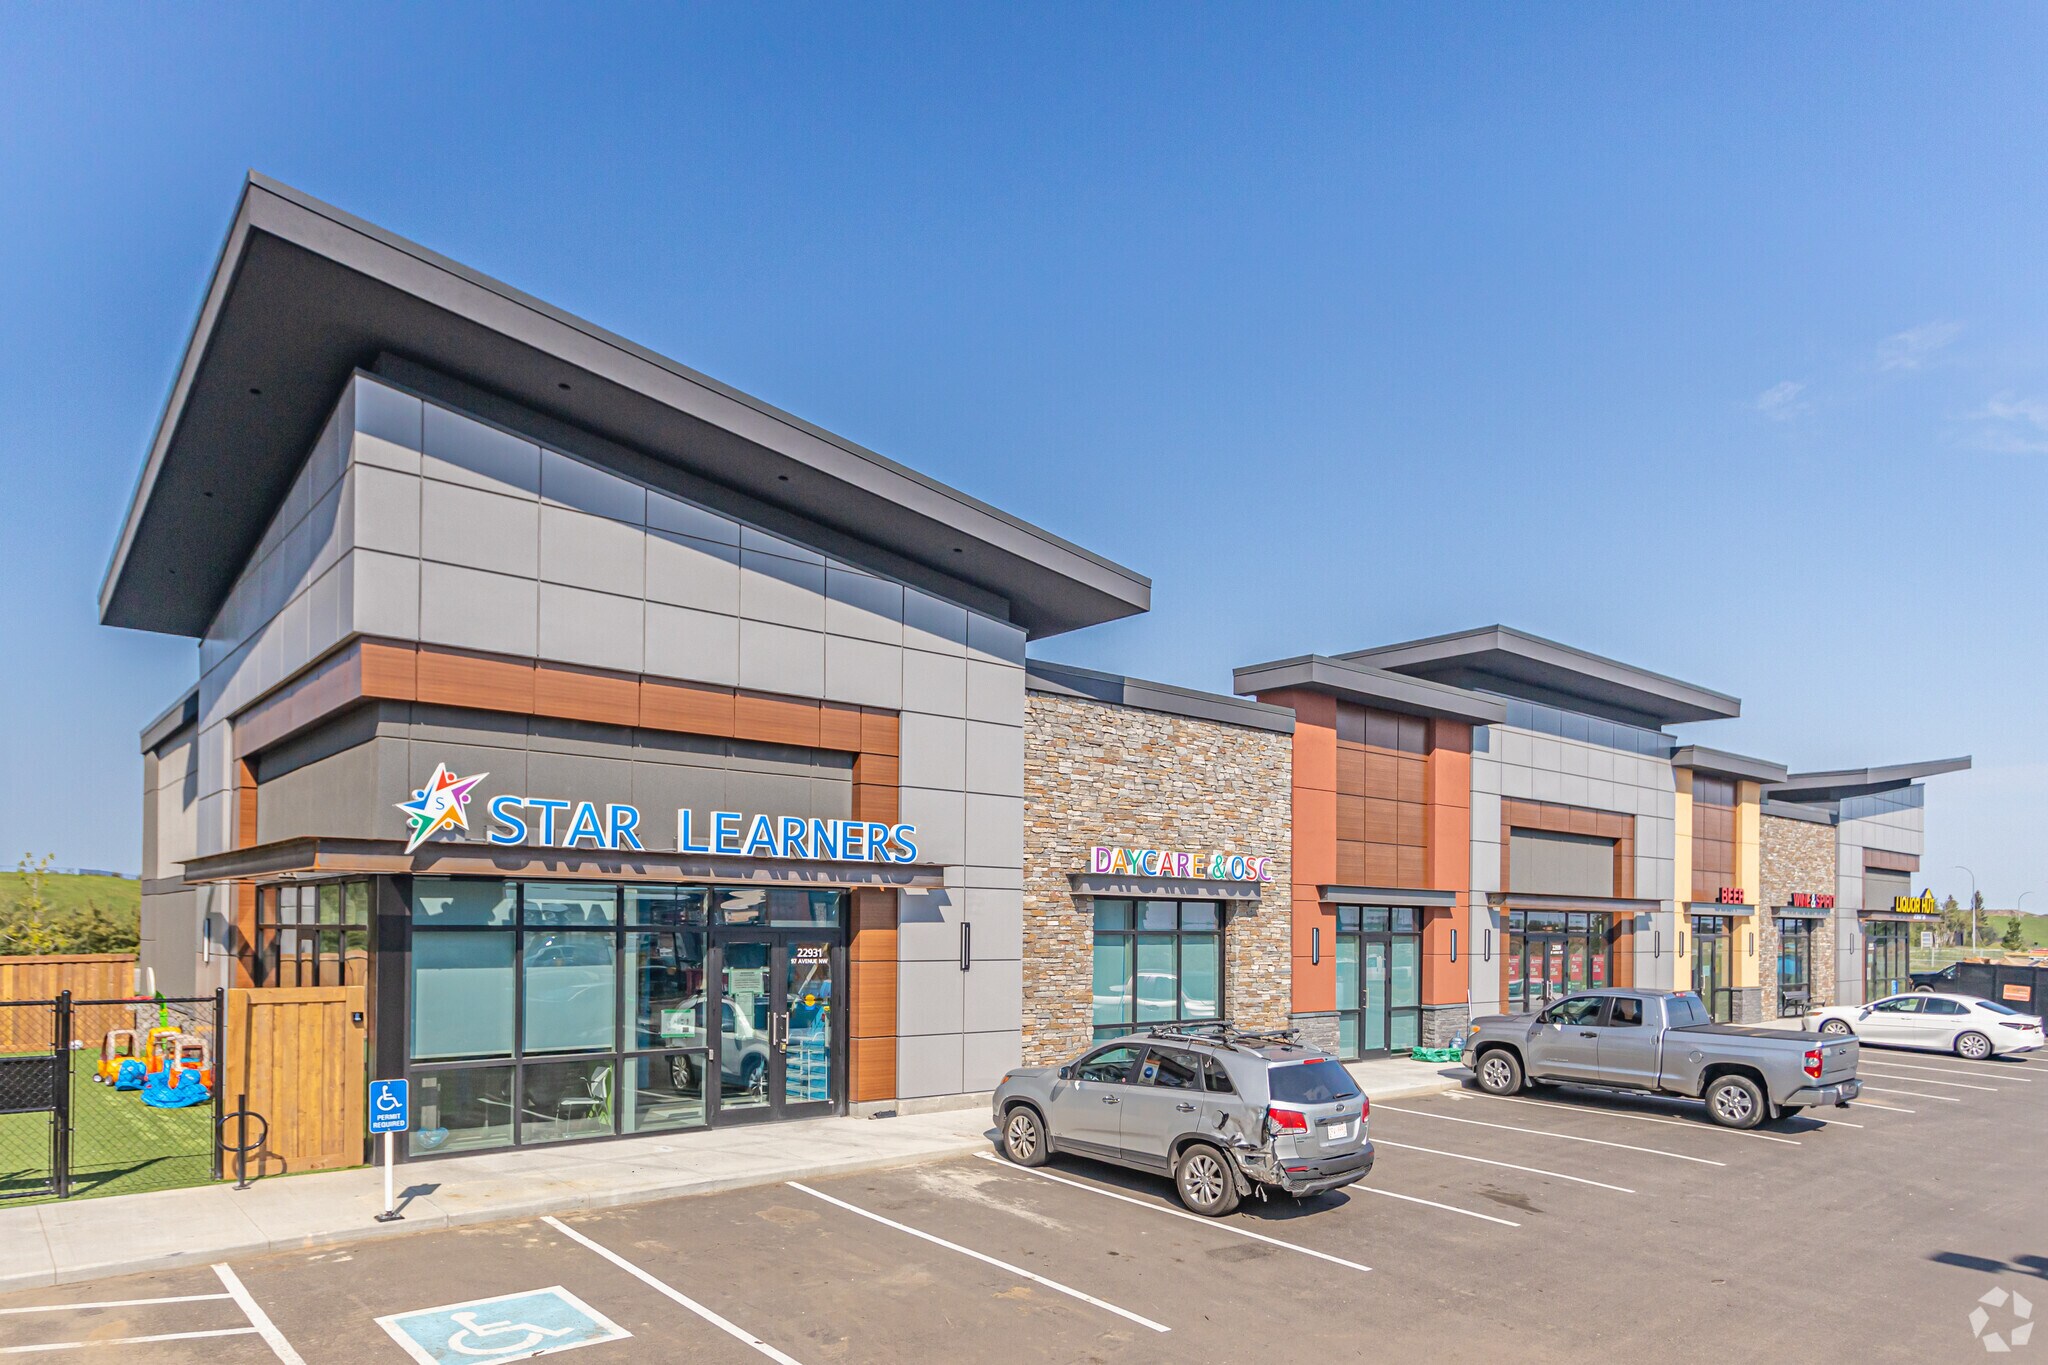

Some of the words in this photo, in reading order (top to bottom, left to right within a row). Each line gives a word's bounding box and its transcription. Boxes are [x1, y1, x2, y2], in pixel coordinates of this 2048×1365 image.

[435, 796, 446, 811] S
[488, 794, 644, 851] STAR
[679, 807, 918, 864] LEARNERS
[1093, 847, 1206, 878] DAYCARE
[1211, 853, 1226, 879] &
[1230, 855, 1273, 882] OSC
[1721, 887, 1744, 904] BEER
[1895, 896, 1920, 913] LIQUOR
[1921, 898, 1935, 914] HUT
[797, 948, 822, 957] 22931
[373, 1120, 405, 1128] REQUIRED
